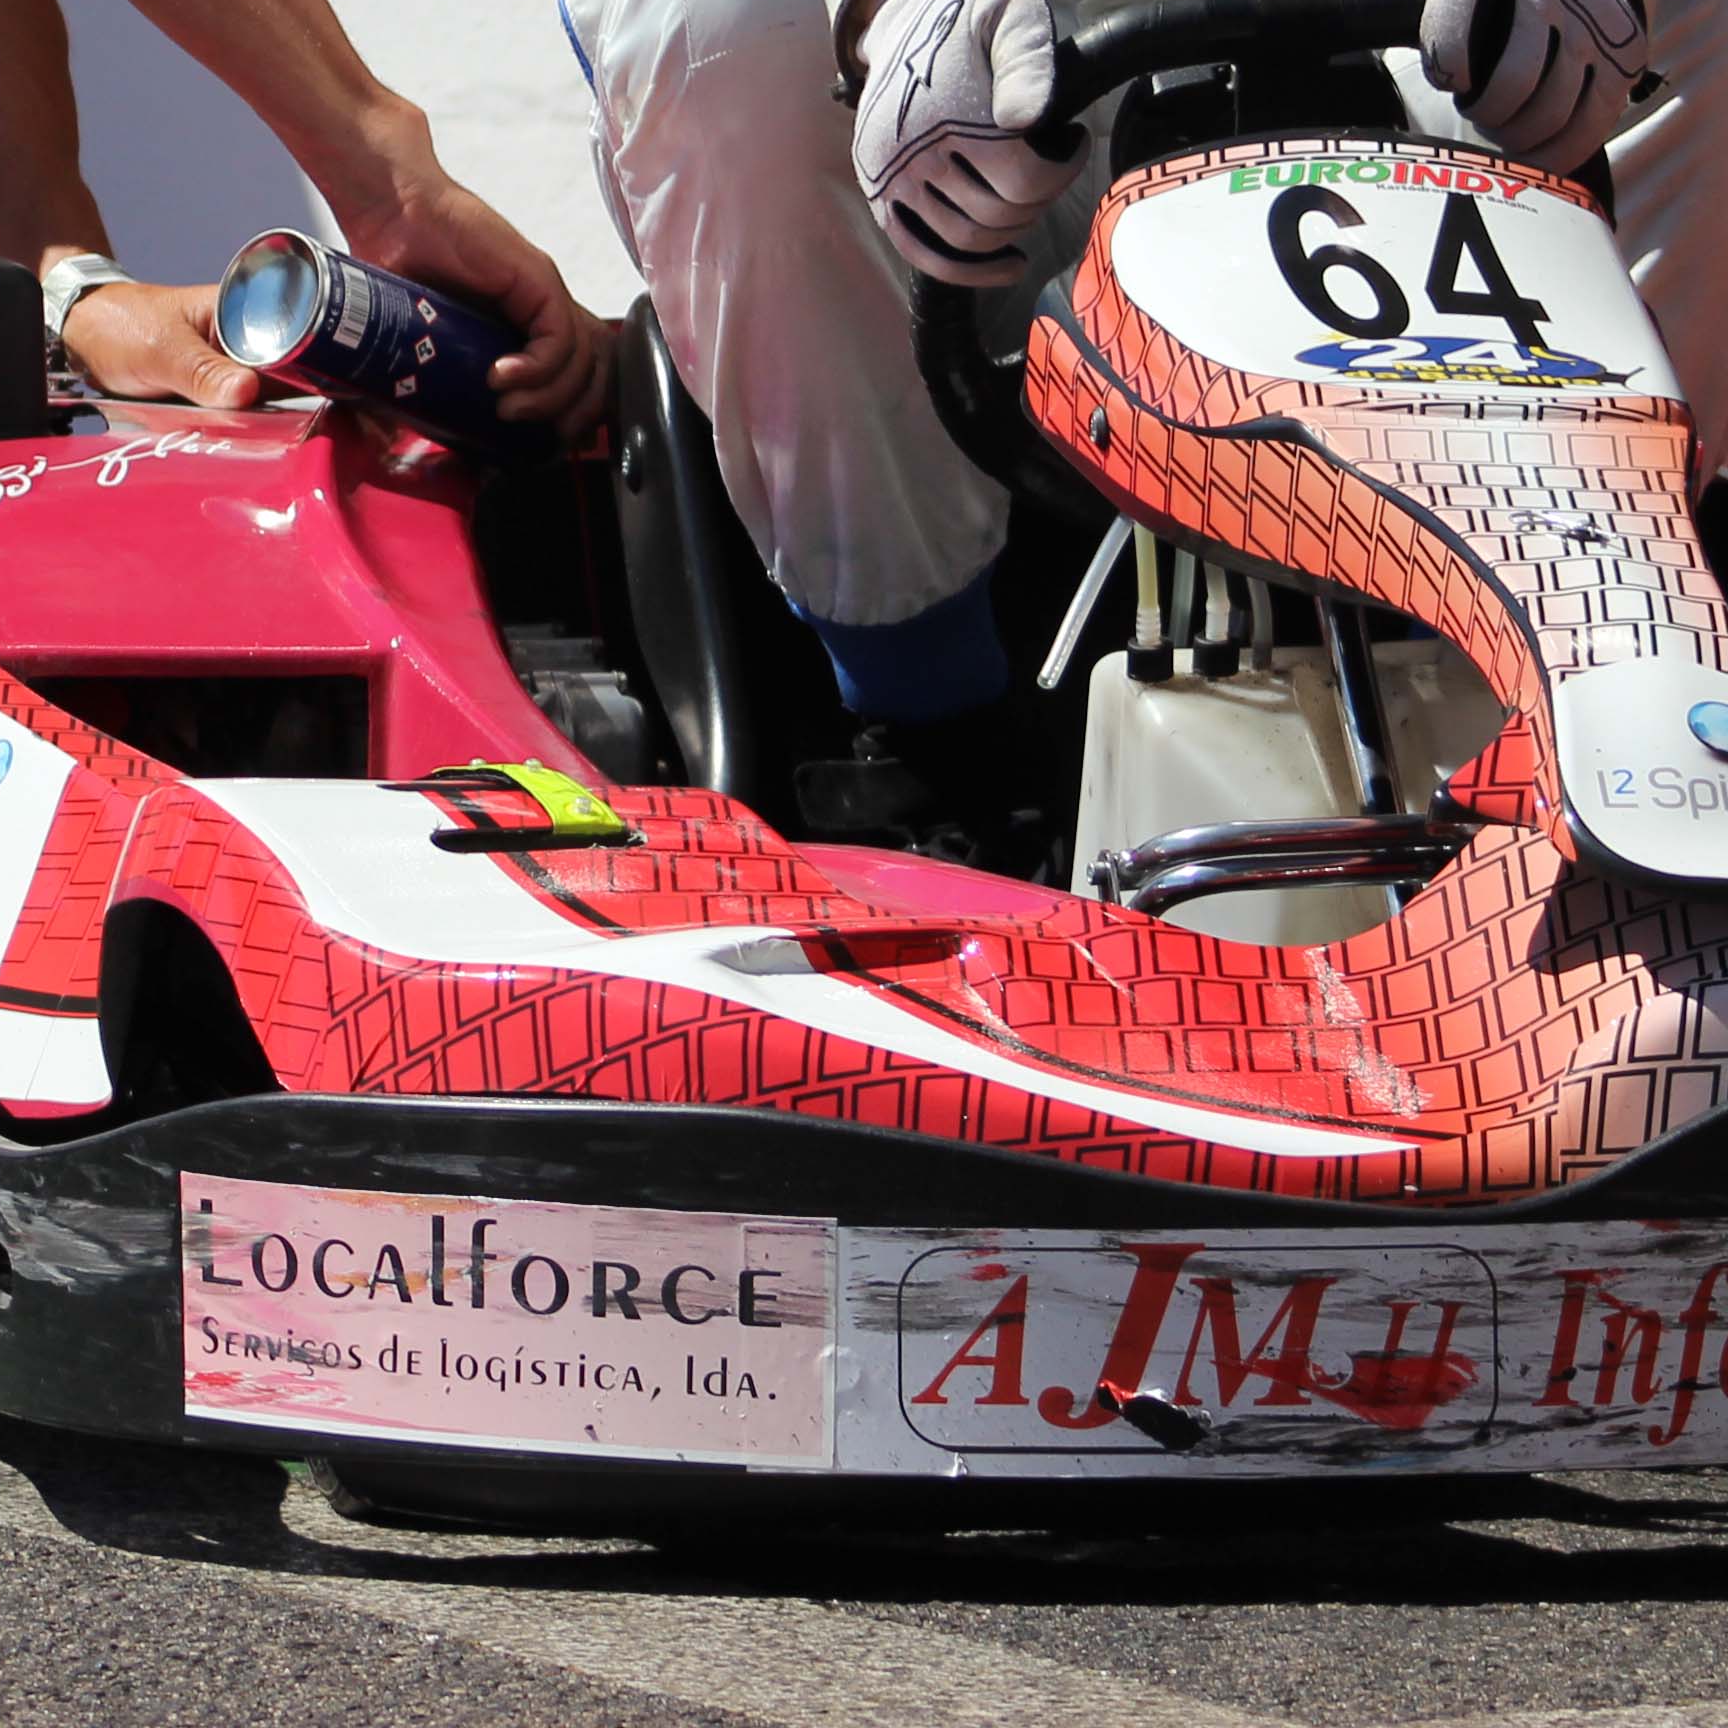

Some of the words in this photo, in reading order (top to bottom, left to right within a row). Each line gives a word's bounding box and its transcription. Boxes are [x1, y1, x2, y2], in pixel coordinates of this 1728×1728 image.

[1228, 160, 1530, 201] EUROINDY
[1267, 184, 1553, 351] 64
[1338, 338, 1540, 372] 24
[1415, 371, 1601, 386] Batalha
[910, 1242, 1339, 1430] AJM
